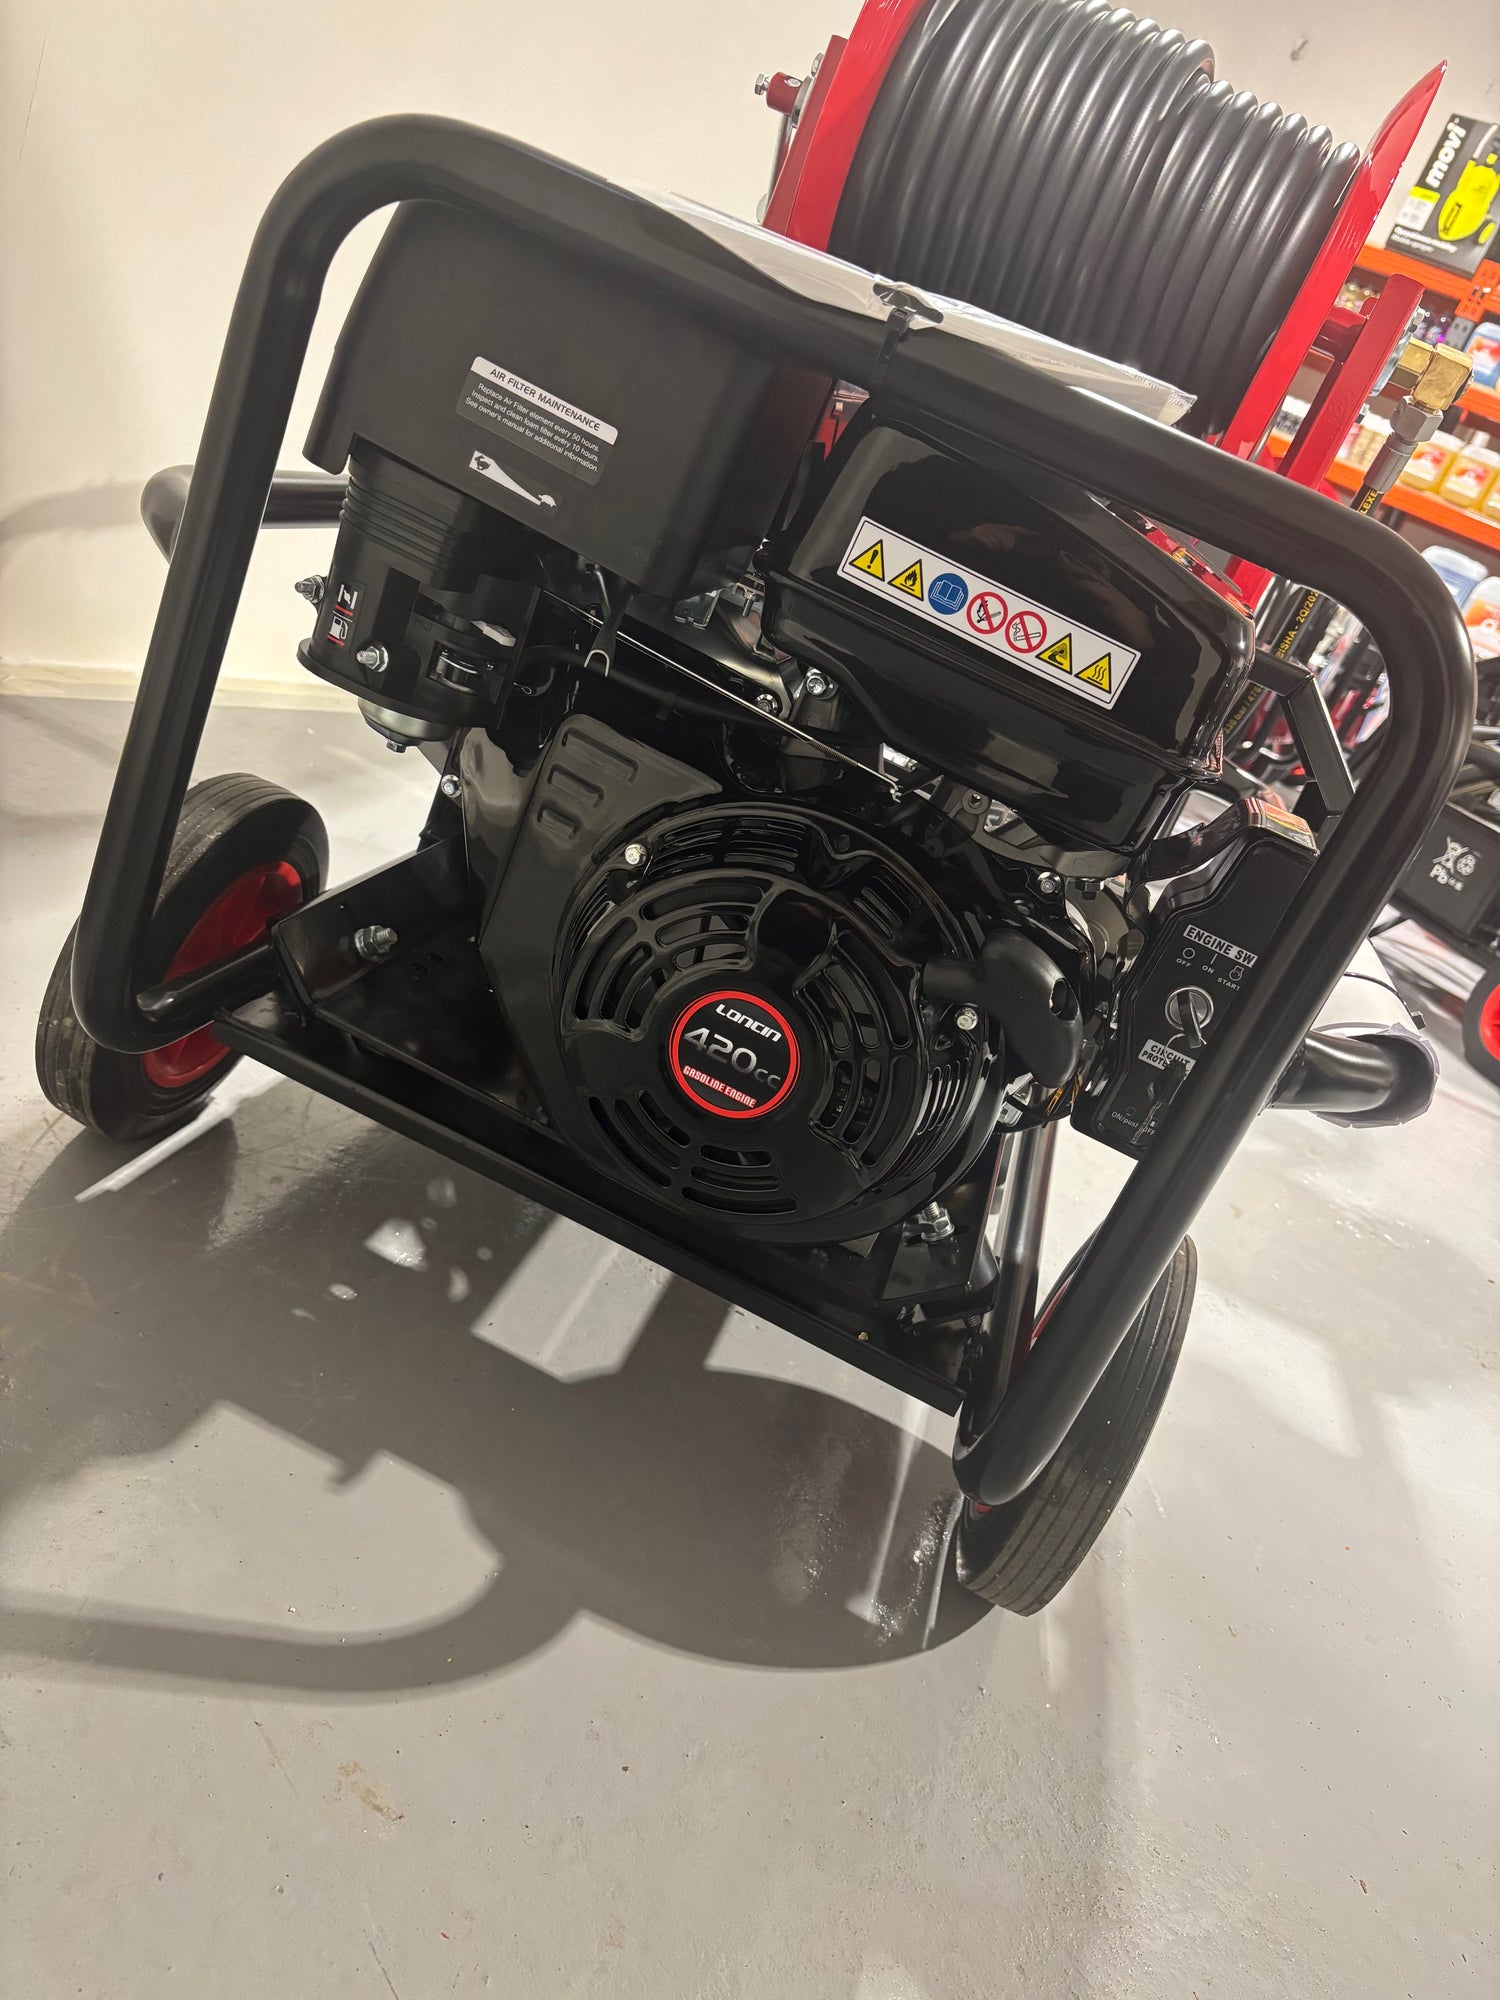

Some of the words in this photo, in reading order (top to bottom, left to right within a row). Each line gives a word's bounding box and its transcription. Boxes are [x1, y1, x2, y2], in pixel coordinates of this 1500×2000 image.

[1425, 121, 1467, 189] movi
[471, 389, 494, 407] Inspect
[494, 402, 507, 413] and
[506, 408, 524, 422] clean
[523, 417, 540, 430] foam
[539, 425, 554, 438] filter
[554, 434, 572, 448] every
[572, 443, 581, 452] 10
[580, 447, 600, 463] hours.
[478, 382, 503, 401] Replace
[503, 396, 513, 406] Air
[513, 401, 530, 415] Filter
[529, 410, 554, 428] element
[554, 424, 572, 438] every
[572, 432, 581, 442] 50
[490, 368, 506, 382] AIR
[507, 377, 537, 398] FILTER
[537, 392, 601, 432] MAINTENANCE
[465, 396, 479, 409] See
[478, 405, 502, 421] owner's
[501, 417, 525, 433] manual
[524, 428, 534, 438] for
[533, 434, 565, 454] additional
[563, 449, 599, 473] information.
[1176, 957, 1193, 969] OFF
[1202, 964, 1215, 975] ON
[1217, 976, 1241, 991] START
[1186, 927, 1233, 956] ENGINE
[1234, 948, 1256, 966] SW
[682, 1065, 725, 1093] GASOLINE
[724, 1085, 758, 1109] ENGINE
